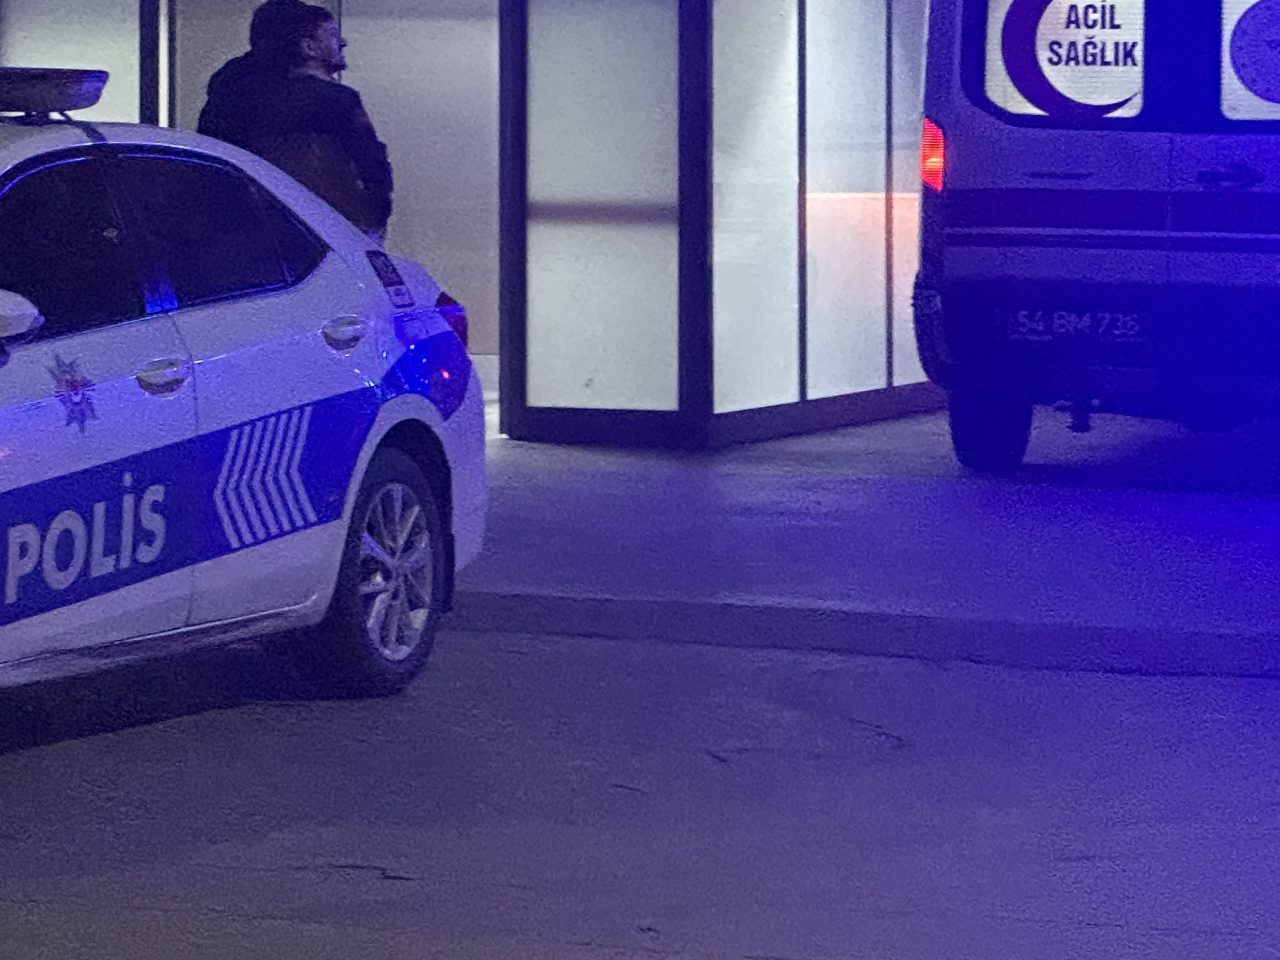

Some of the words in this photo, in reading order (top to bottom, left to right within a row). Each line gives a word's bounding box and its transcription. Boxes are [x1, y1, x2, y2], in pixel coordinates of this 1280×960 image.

[1065, 0, 1122, 30] ACİL
[1047, 35, 1138, 67] SAĞLIK
[5, 471, 167, 604] POLİS
